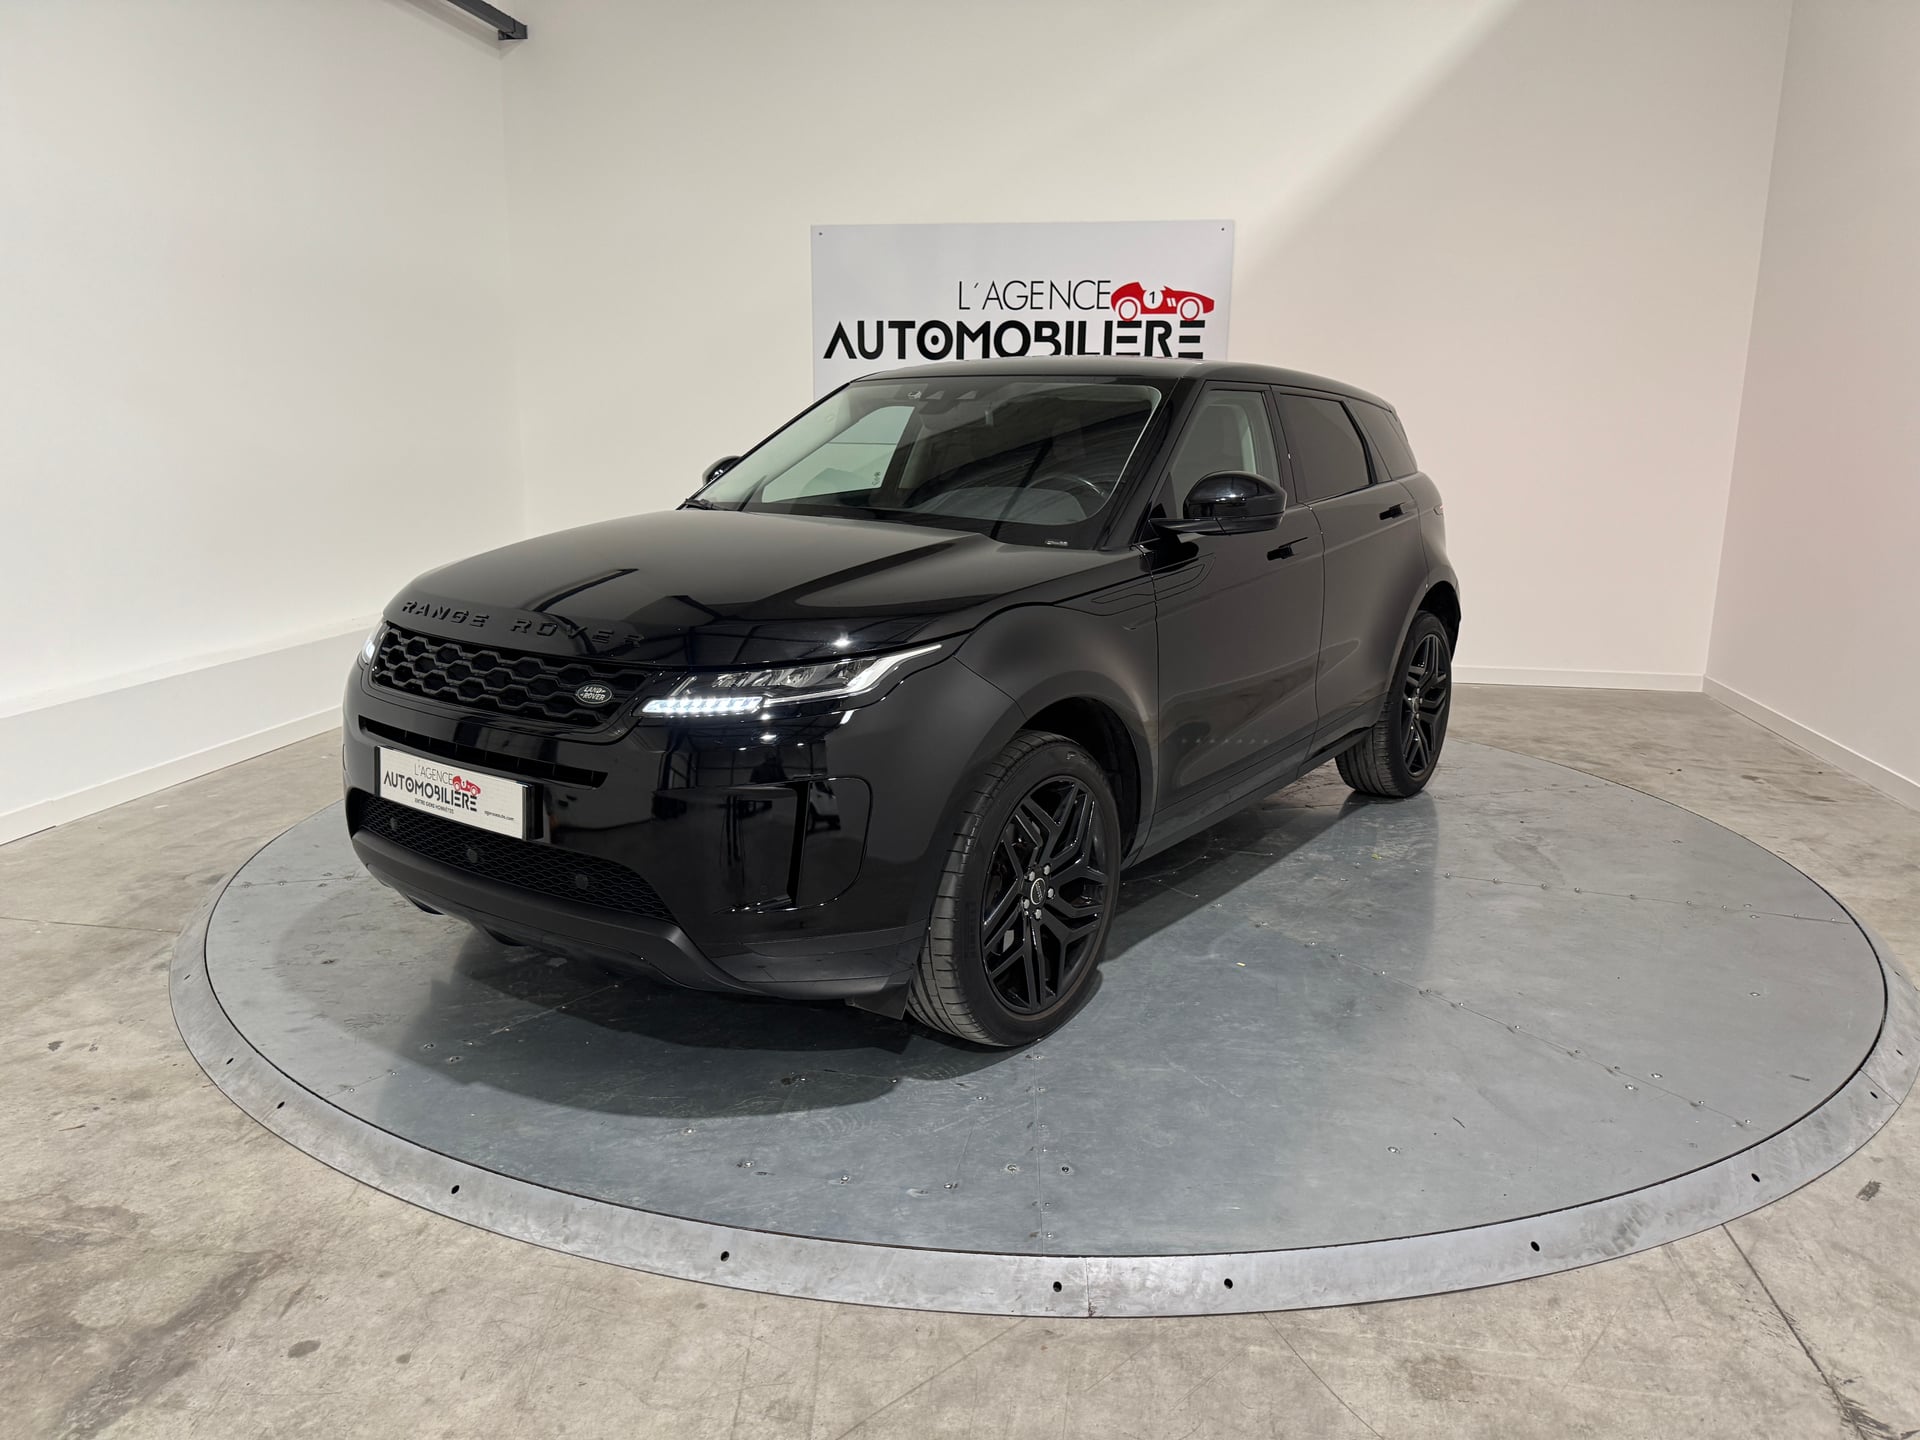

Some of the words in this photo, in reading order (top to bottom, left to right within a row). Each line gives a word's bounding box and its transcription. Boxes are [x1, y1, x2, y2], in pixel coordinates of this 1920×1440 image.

[1149, 290, 1156, 305] 1
[402, 600, 489, 628] RANGE
[510, 619, 644, 648] ROVER
[583, 692, 605, 700] ROVER
